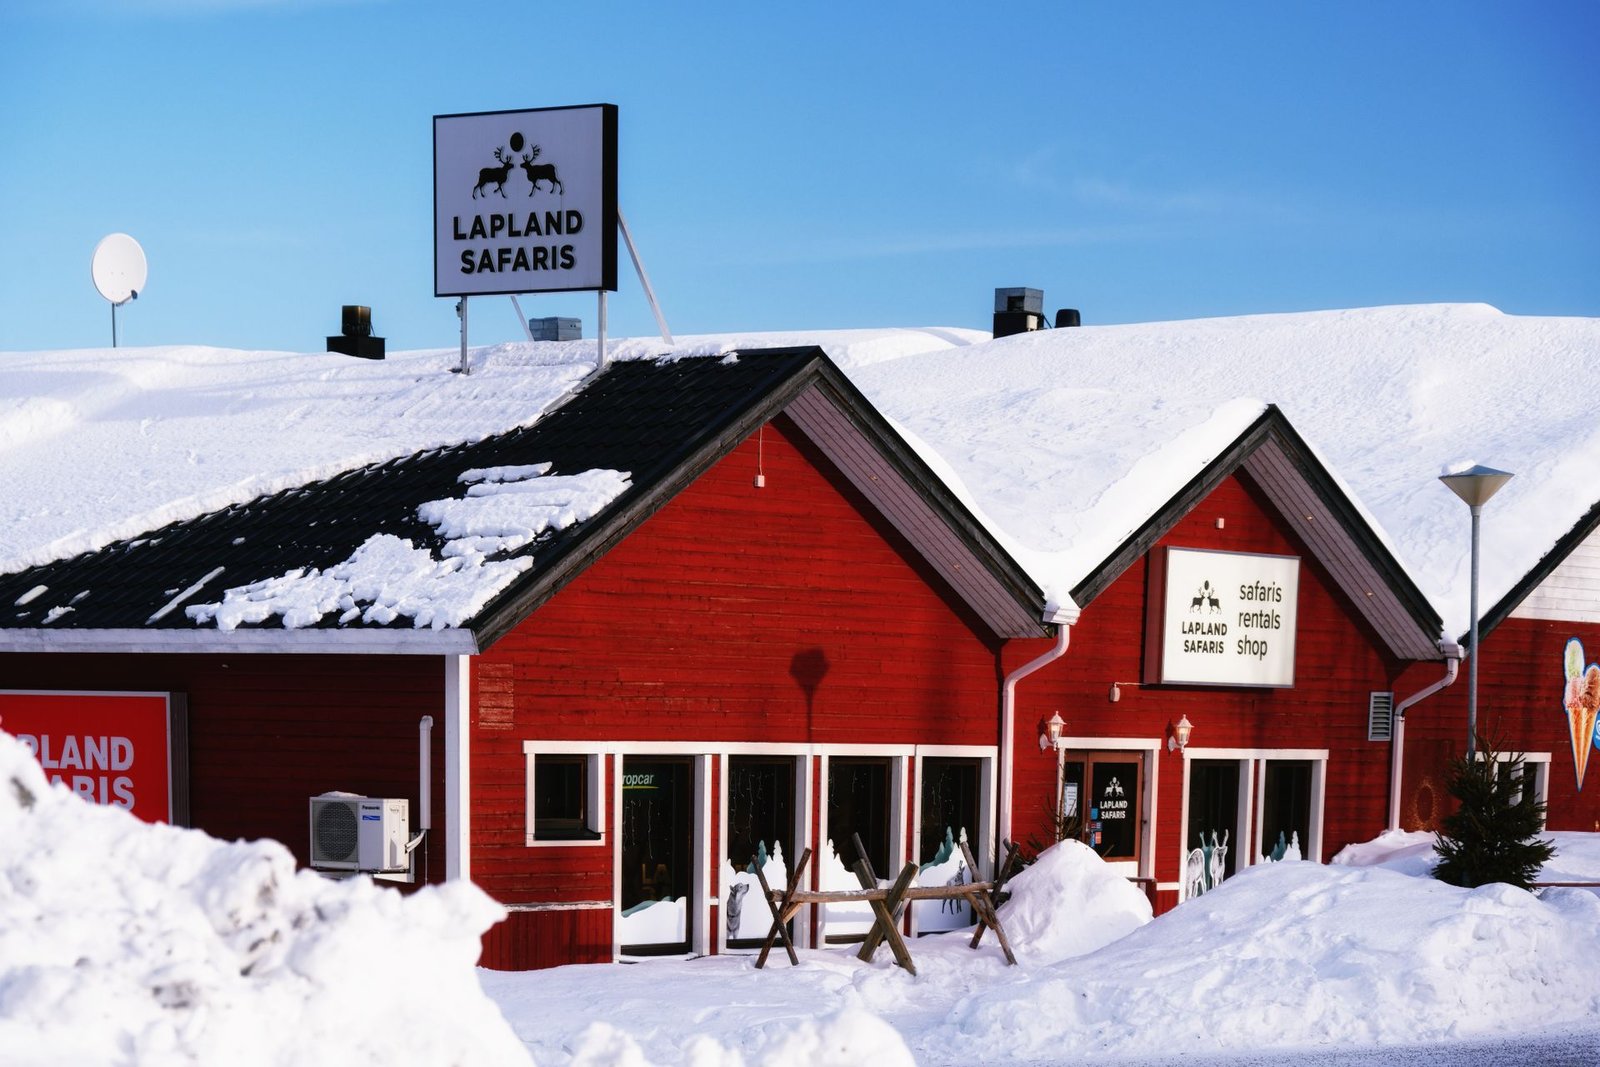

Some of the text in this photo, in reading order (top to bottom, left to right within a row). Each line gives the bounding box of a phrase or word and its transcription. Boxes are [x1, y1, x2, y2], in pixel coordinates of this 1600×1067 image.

[453, 210, 583, 240] LAPLAND
[460, 245, 576, 274] SAFARIS
[1239, 580, 1282, 603] safaris
[1181, 621, 1228, 636] LAPLAND
[1238, 609, 1281, 630] rentals
[1183, 639, 1225, 654] SAFARIS
[1236, 634, 1268, 661] shop
[1100, 800, 1128, 809] LAPLAND
[1101, 810, 1126, 819] SAFARIS
